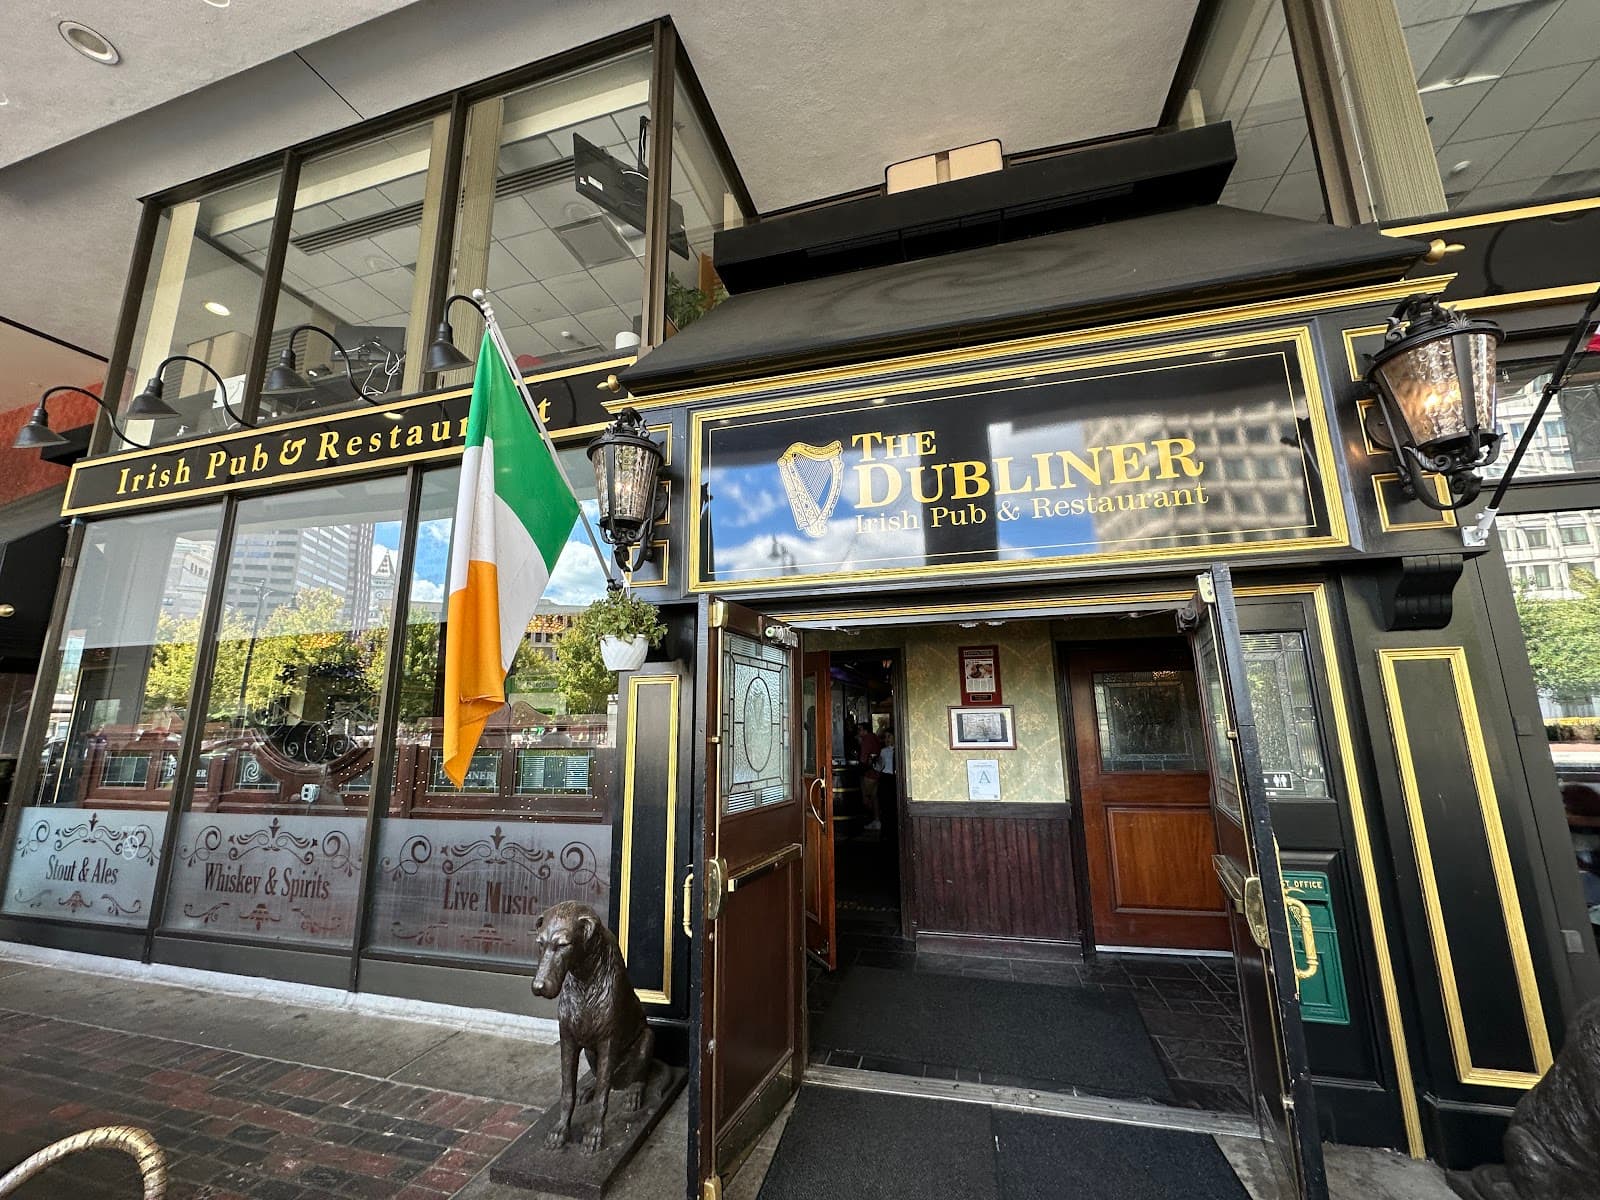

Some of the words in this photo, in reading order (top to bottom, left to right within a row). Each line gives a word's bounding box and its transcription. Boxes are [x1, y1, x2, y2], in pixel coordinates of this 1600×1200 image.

[116, 457, 190, 495] Irish
[205, 443, 269, 480] Pub
[279, 436, 307, 466] &
[852, 430, 937, 462] THE
[853, 438, 1204, 509] DUBLINER
[856, 510, 920, 534] Irish
[930, 503, 987, 529] Pub
[997, 500, 1020, 522] &
[1032, 481, 1209, 520] Restaurant
[46, 855, 77, 882] Stout
[79, 857, 90, 883] &
[91, 858, 119, 885] Ales
[205, 862, 262, 895] Whiskey
[265, 867, 278, 896] &
[281, 867, 330, 903] Spirits
[1293, 879, 1323, 889] OFFICE
[444, 878, 479, 911] Live
[485, 880, 538, 916] Music
